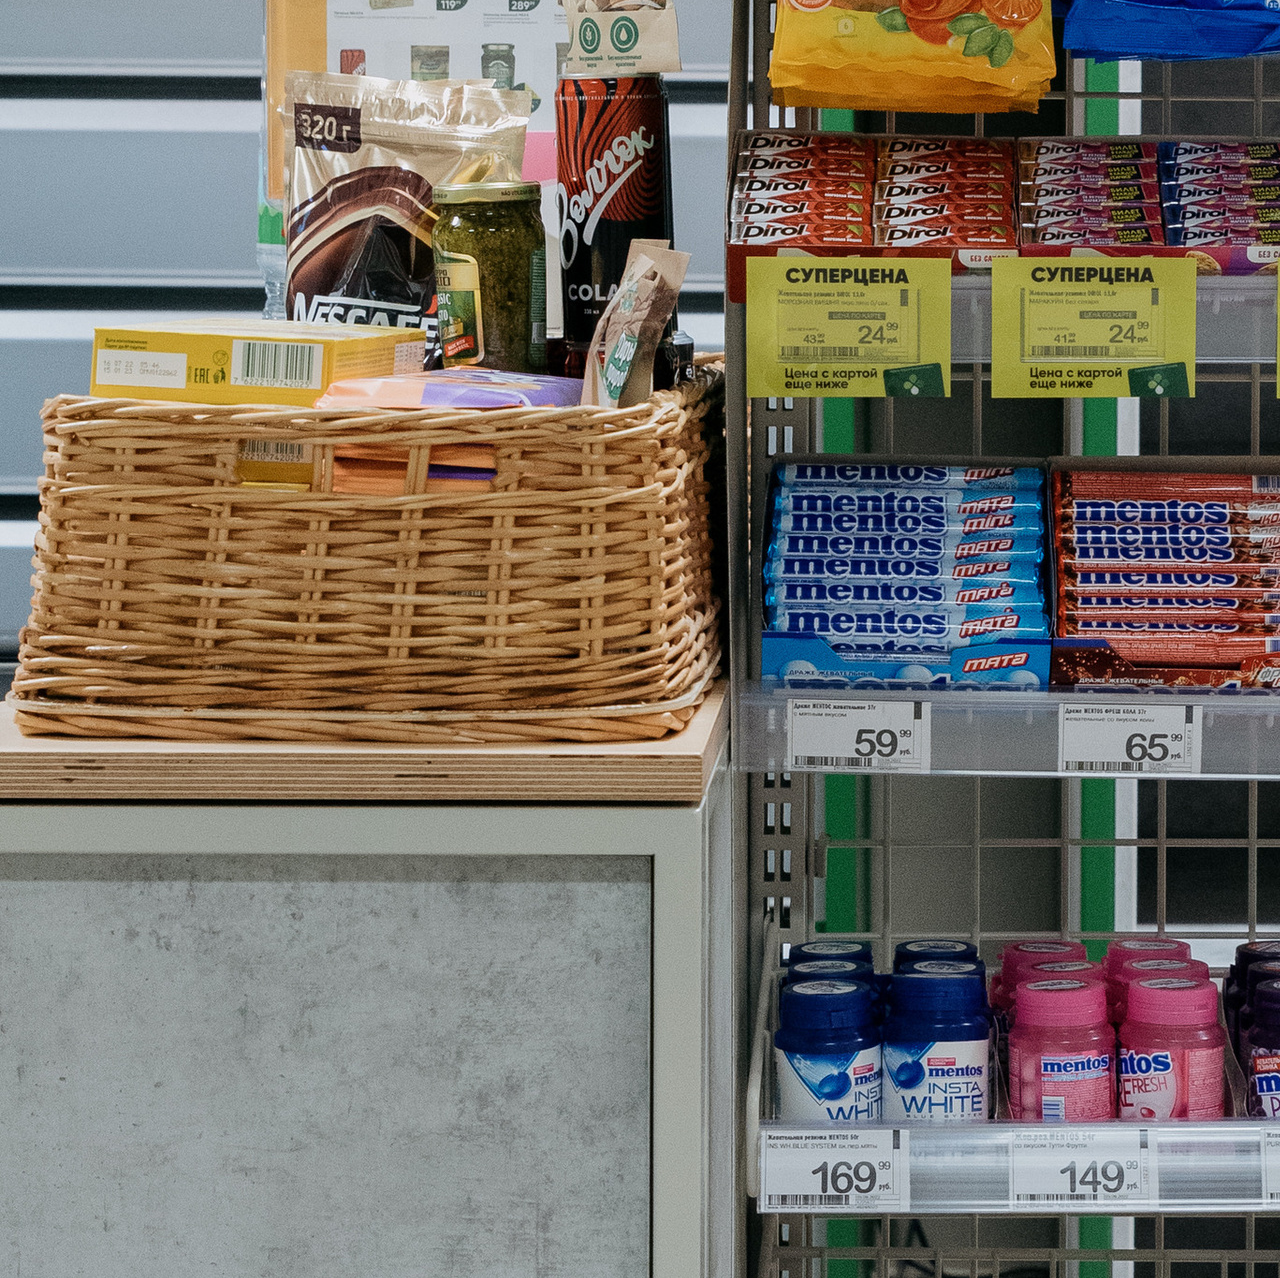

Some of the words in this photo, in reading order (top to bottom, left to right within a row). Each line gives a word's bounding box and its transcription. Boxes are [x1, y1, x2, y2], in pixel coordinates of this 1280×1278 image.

[299, 113, 338, 141] 320
[742, 225, 805, 240] Dirol
[1258, 251, 1272, 259] БЕЗ
[785, 267, 910, 286] СУПЕРЦЕНА
[1031, 267, 1154, 286] СУПЕРЦЕНА
[1073, 500, 1230, 526] mentos
[785, 609, 948, 636] mentos
[854, 728, 898, 758] 59
[1125, 732, 1169, 762] 65
[928, 1062, 983, 1078] mentos
[928, 1082, 982, 1095] INSTA
[901, 1094, 984, 1113] WHITE
[811, 1160, 877, 1194] 169
[1059, 1160, 1125, 1193] 149
